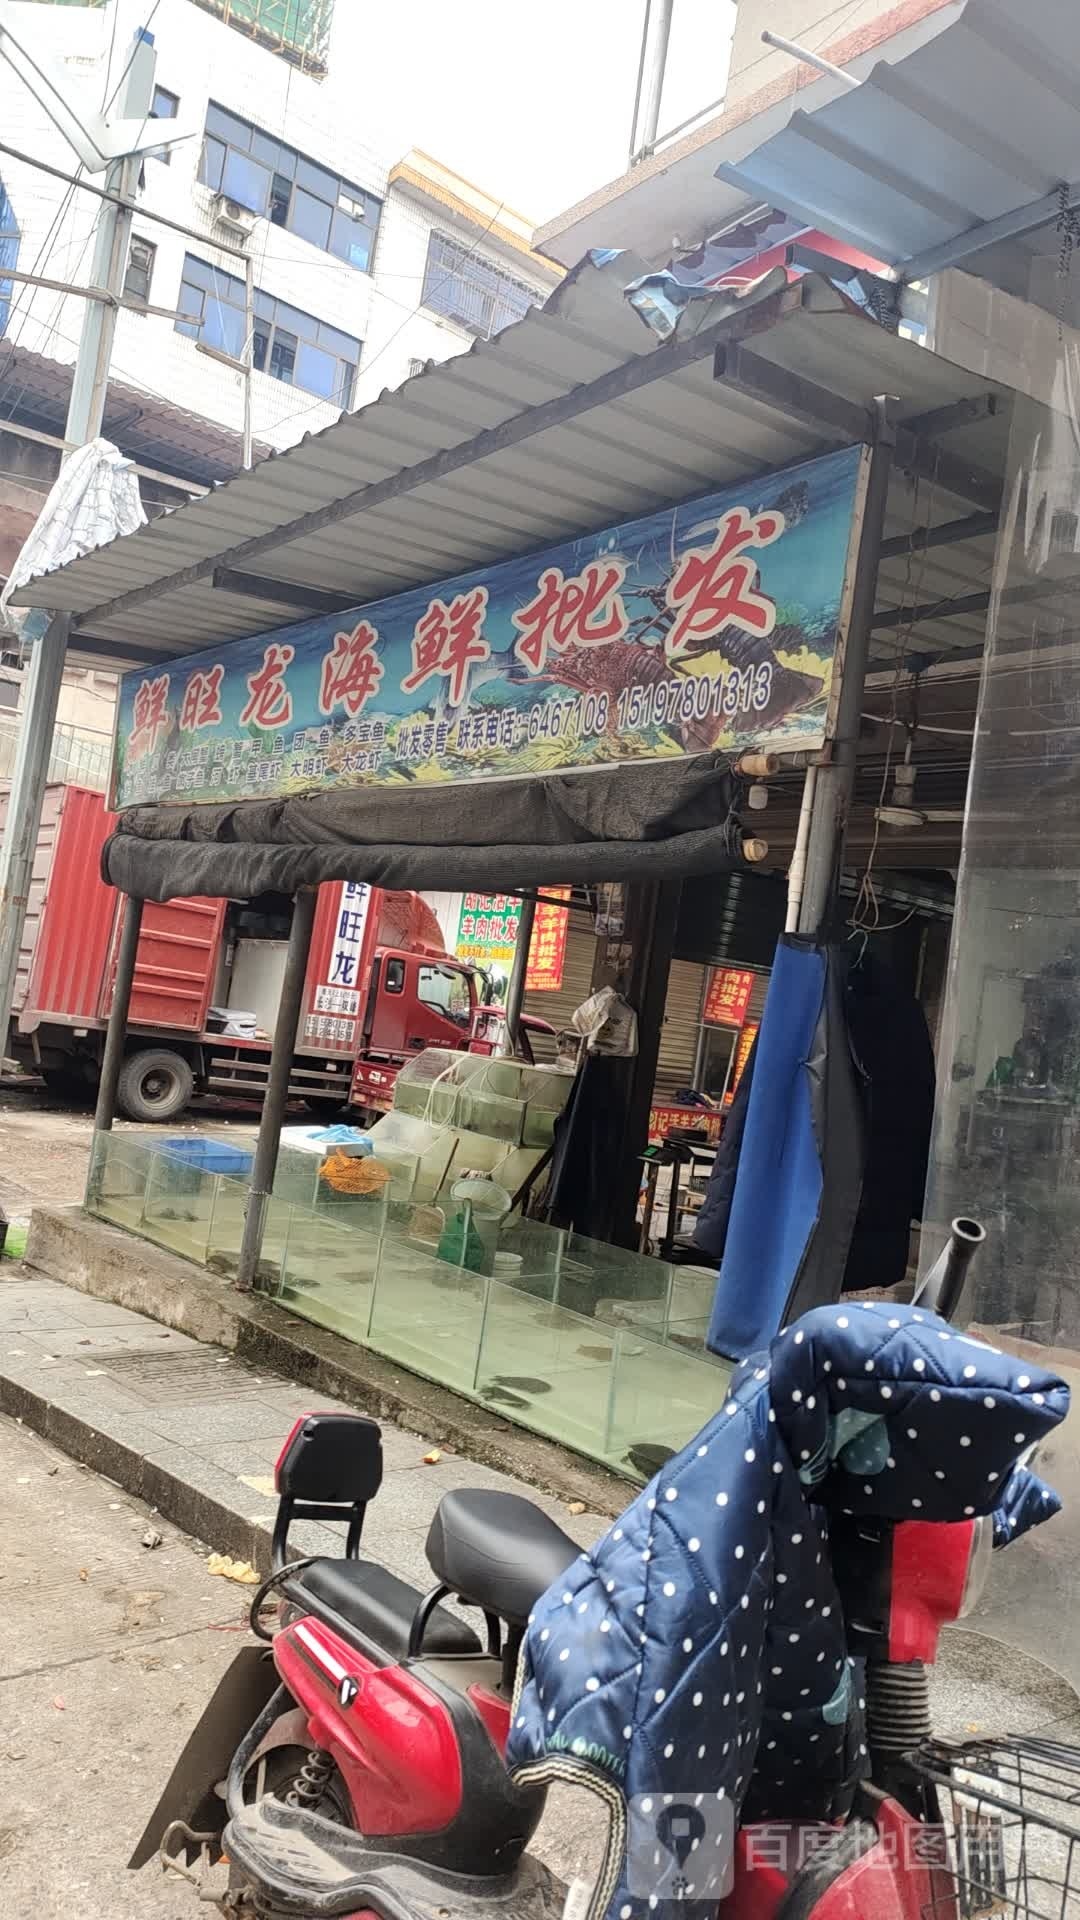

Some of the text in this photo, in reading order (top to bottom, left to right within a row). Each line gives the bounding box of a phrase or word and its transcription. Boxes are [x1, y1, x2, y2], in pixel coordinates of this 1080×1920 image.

[127, 506, 786, 754] 鲜旺龙海鲜批发
[395, 721, 449, 760] 批发零售
[617, 661, 773, 729] 15197801313
[344, 721, 385, 745] 多宝鱼
[290, 756, 330, 777] 大明虾
[341, 751, 383, 773] 大龙虾
[461, 914, 520, 943] 羊肉批发
